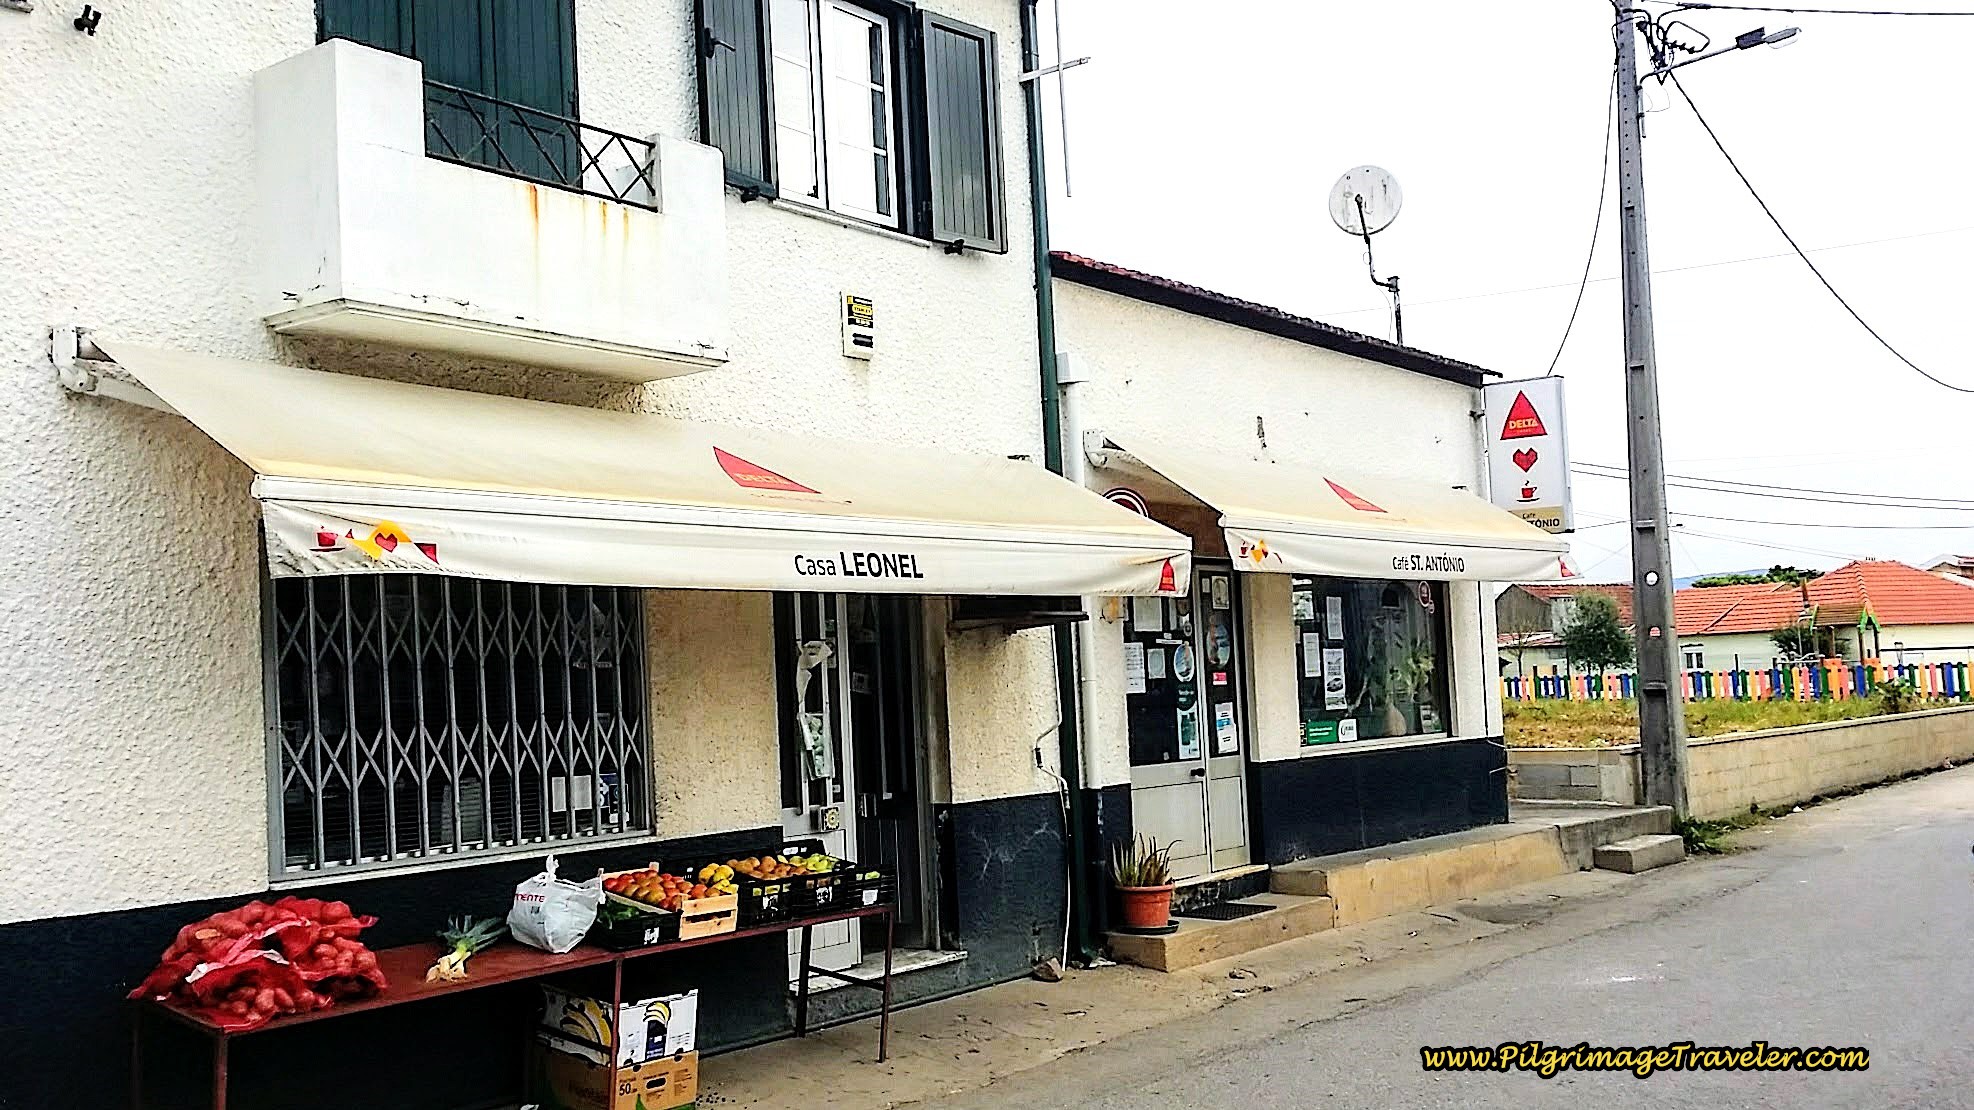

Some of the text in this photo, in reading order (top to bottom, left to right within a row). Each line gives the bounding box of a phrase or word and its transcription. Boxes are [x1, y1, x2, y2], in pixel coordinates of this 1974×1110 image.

[1508, 417, 1539, 430] DELTA
[794, 551, 924, 579] Casa LEONEL
[1392, 552, 1465, 573] Café ST. ANTÓNIO
[619, 1082, 632, 1096] 50
